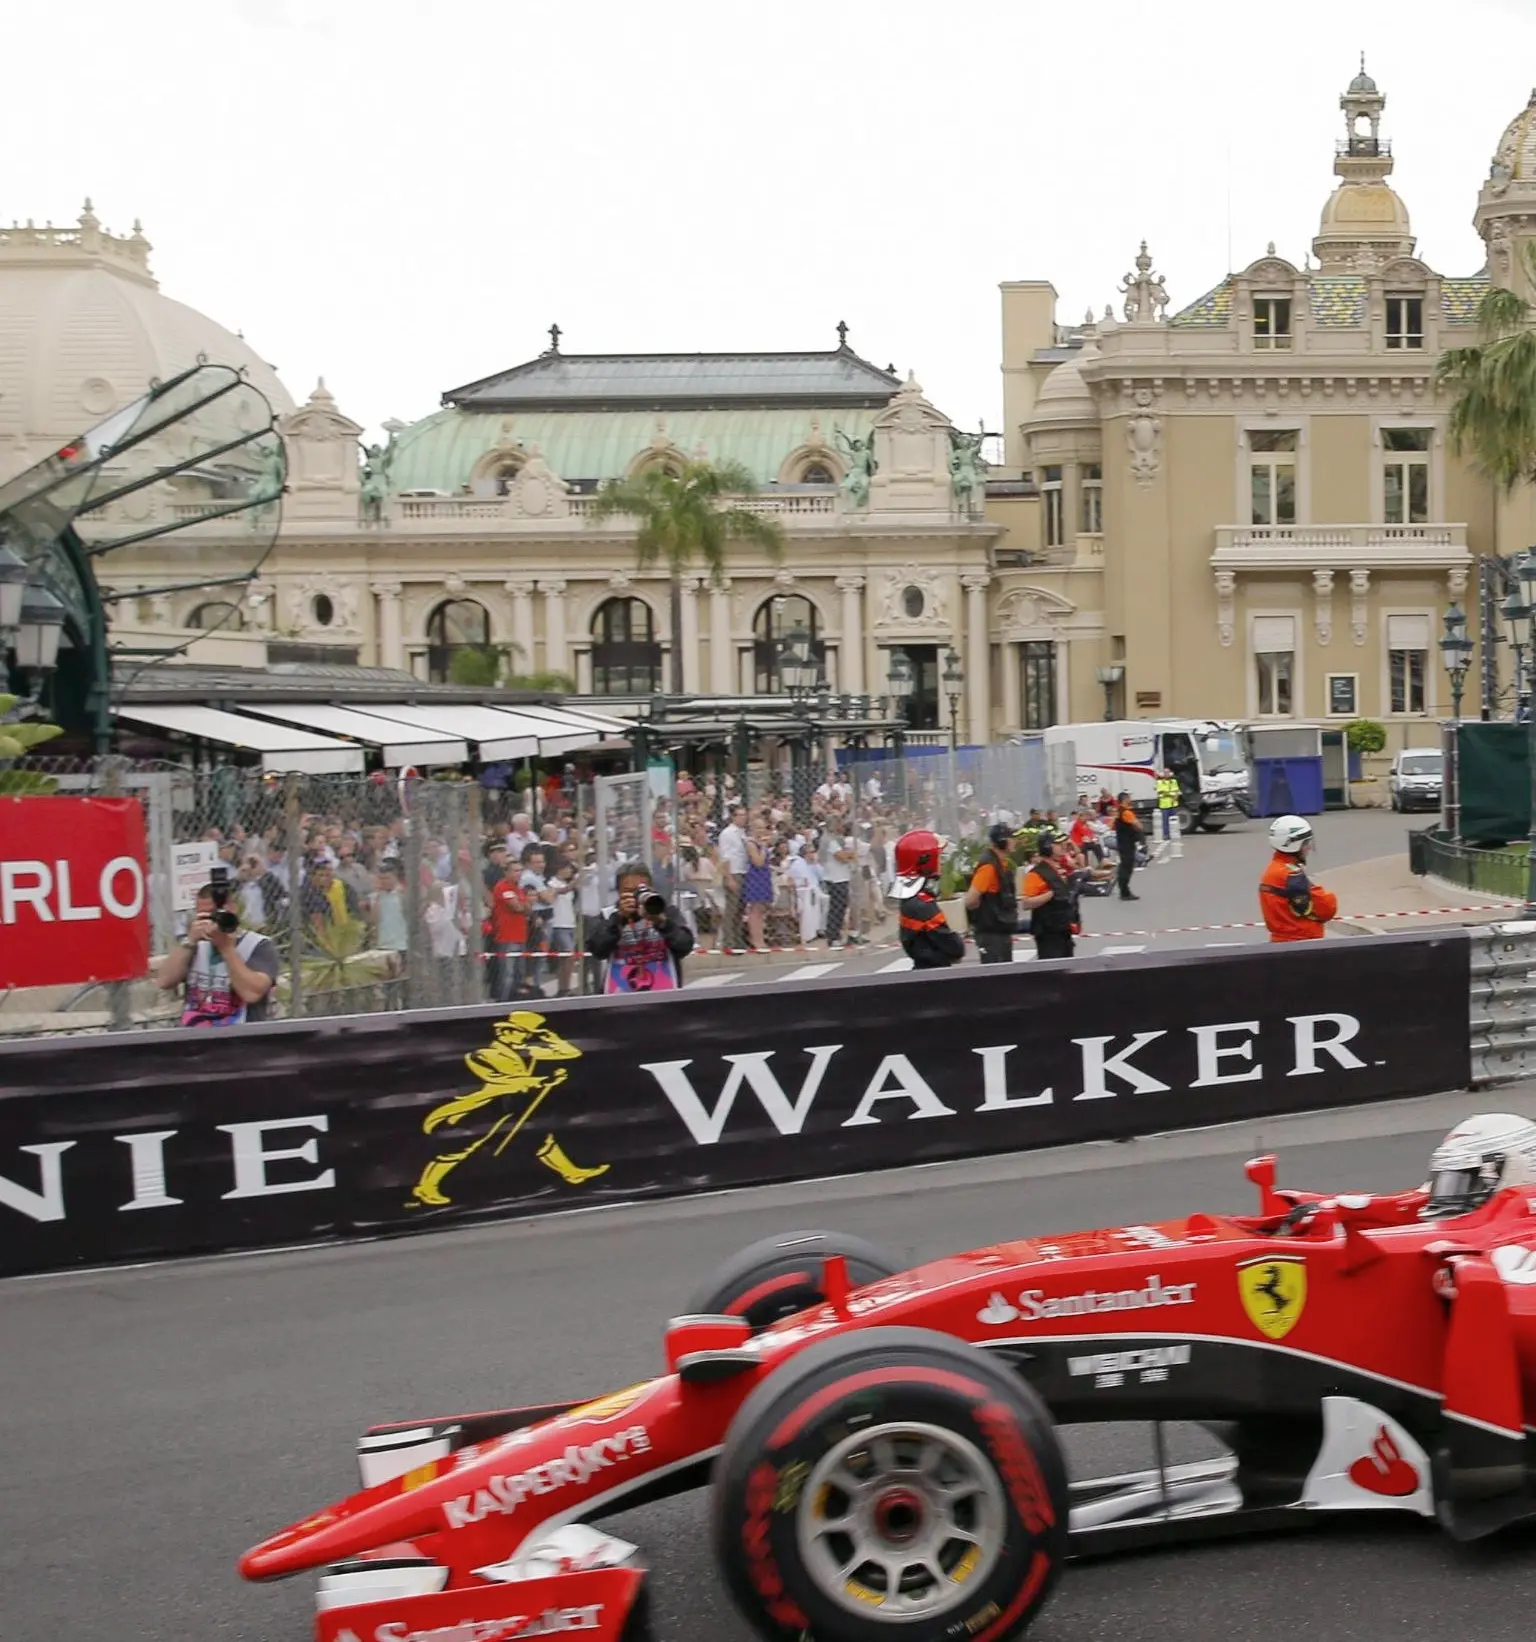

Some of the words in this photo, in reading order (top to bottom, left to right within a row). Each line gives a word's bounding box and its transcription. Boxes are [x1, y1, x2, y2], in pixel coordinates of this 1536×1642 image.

[0, 856, 144, 924] RLO
[639, 1012, 1368, 1145] WALKER
[1018, 1275, 1198, 1321] Santander
